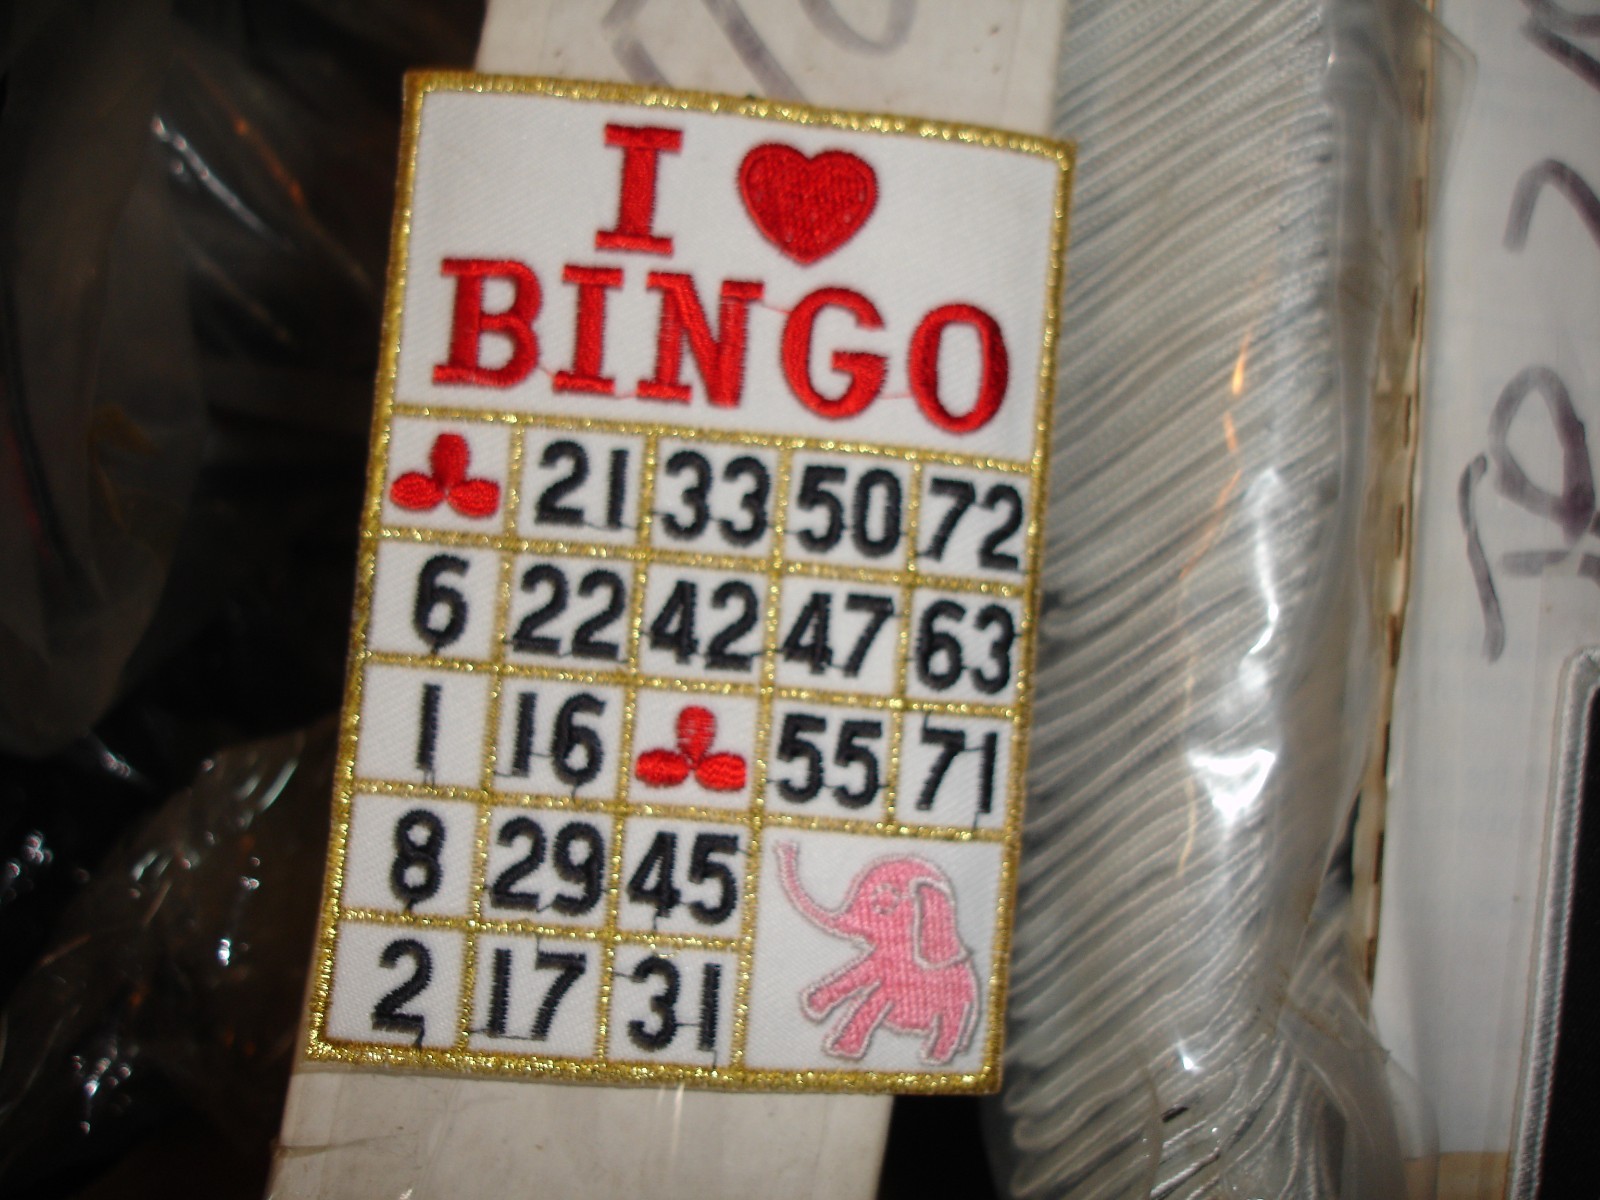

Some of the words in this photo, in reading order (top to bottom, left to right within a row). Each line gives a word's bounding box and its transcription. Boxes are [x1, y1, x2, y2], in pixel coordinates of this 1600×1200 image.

[596, 121, 684, 255] I
[434, 257, 1009, 435] BINGO
[536, 439, 630, 531] 21
[664, 451, 772, 545] 33
[798, 466, 903, 559] 50
[926, 478, 1025, 572] 72
[415, 553, 470, 648] 6
[512, 563, 626, 661] 22
[650, 581, 759, 672] 42
[782, 593, 896, 677] 47
[916, 599, 1015, 693] 63
[417, 685, 441, 773] 1
[513, 693, 606, 788] 16
[778, 714, 883, 810] 55
[920, 728, 999, 815] 71
[390, 808, 446, 902] 8
[489, 817, 606, 918] 29
[628, 832, 739, 924] 45
[372, 938, 432, 1032] 2
[487, 948, 587, 1041] 17
[629, 957, 722, 1052] 31
